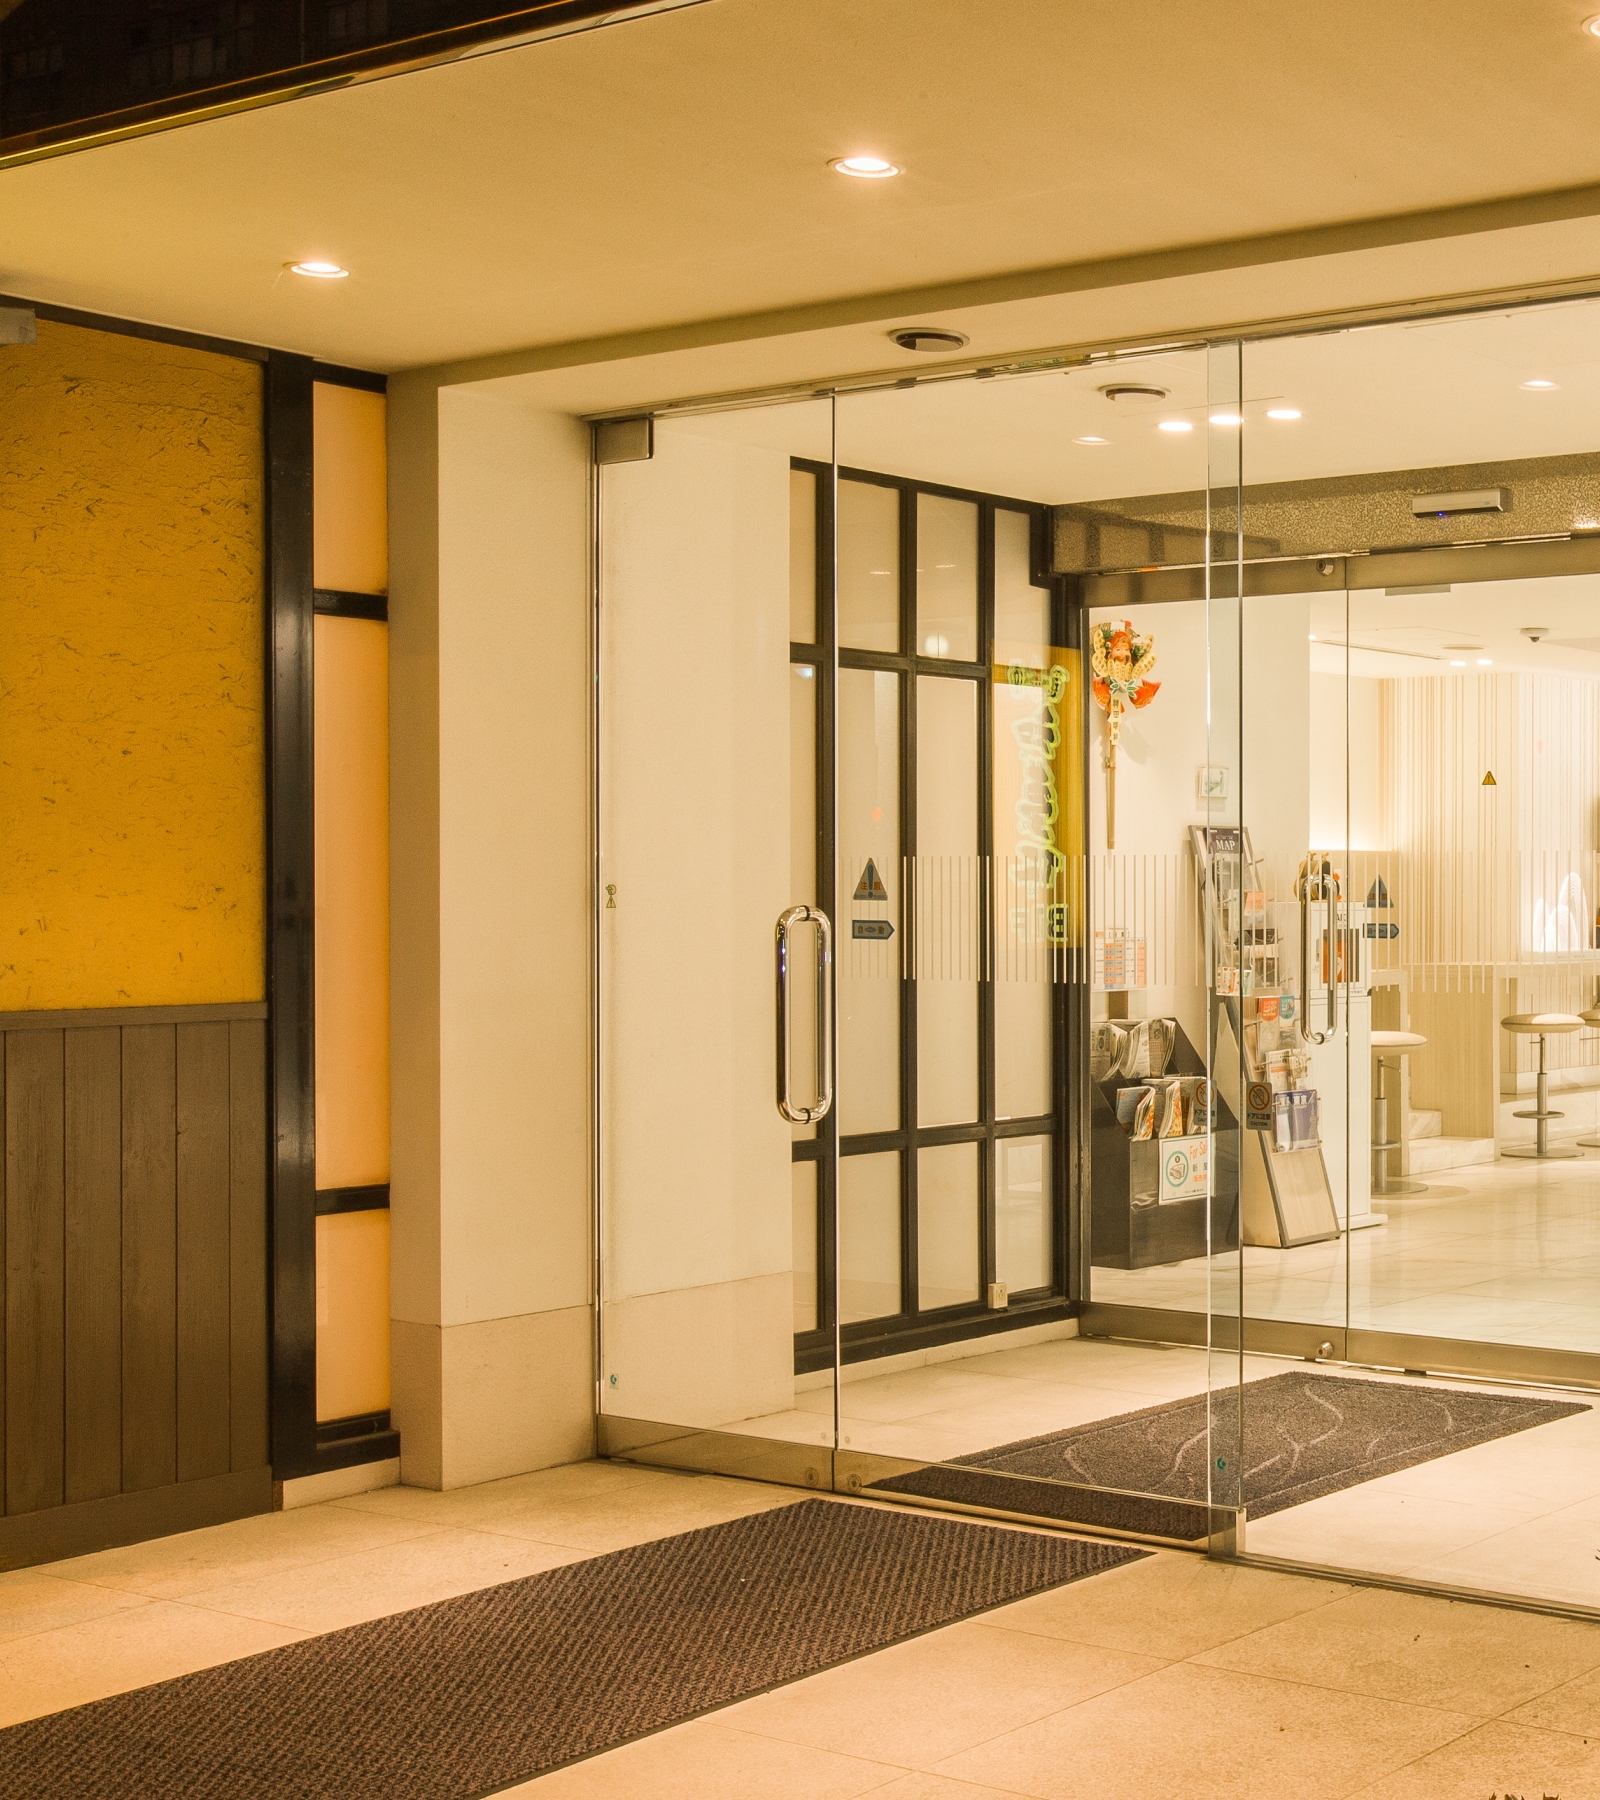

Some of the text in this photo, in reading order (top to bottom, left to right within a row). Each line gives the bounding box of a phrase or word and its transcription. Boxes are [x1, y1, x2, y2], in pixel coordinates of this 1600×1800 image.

[1216, 840, 1235, 851] MAP
[1194, 1109, 1216, 1117] ドアに意
[1190, 1145, 1198, 1161] For
